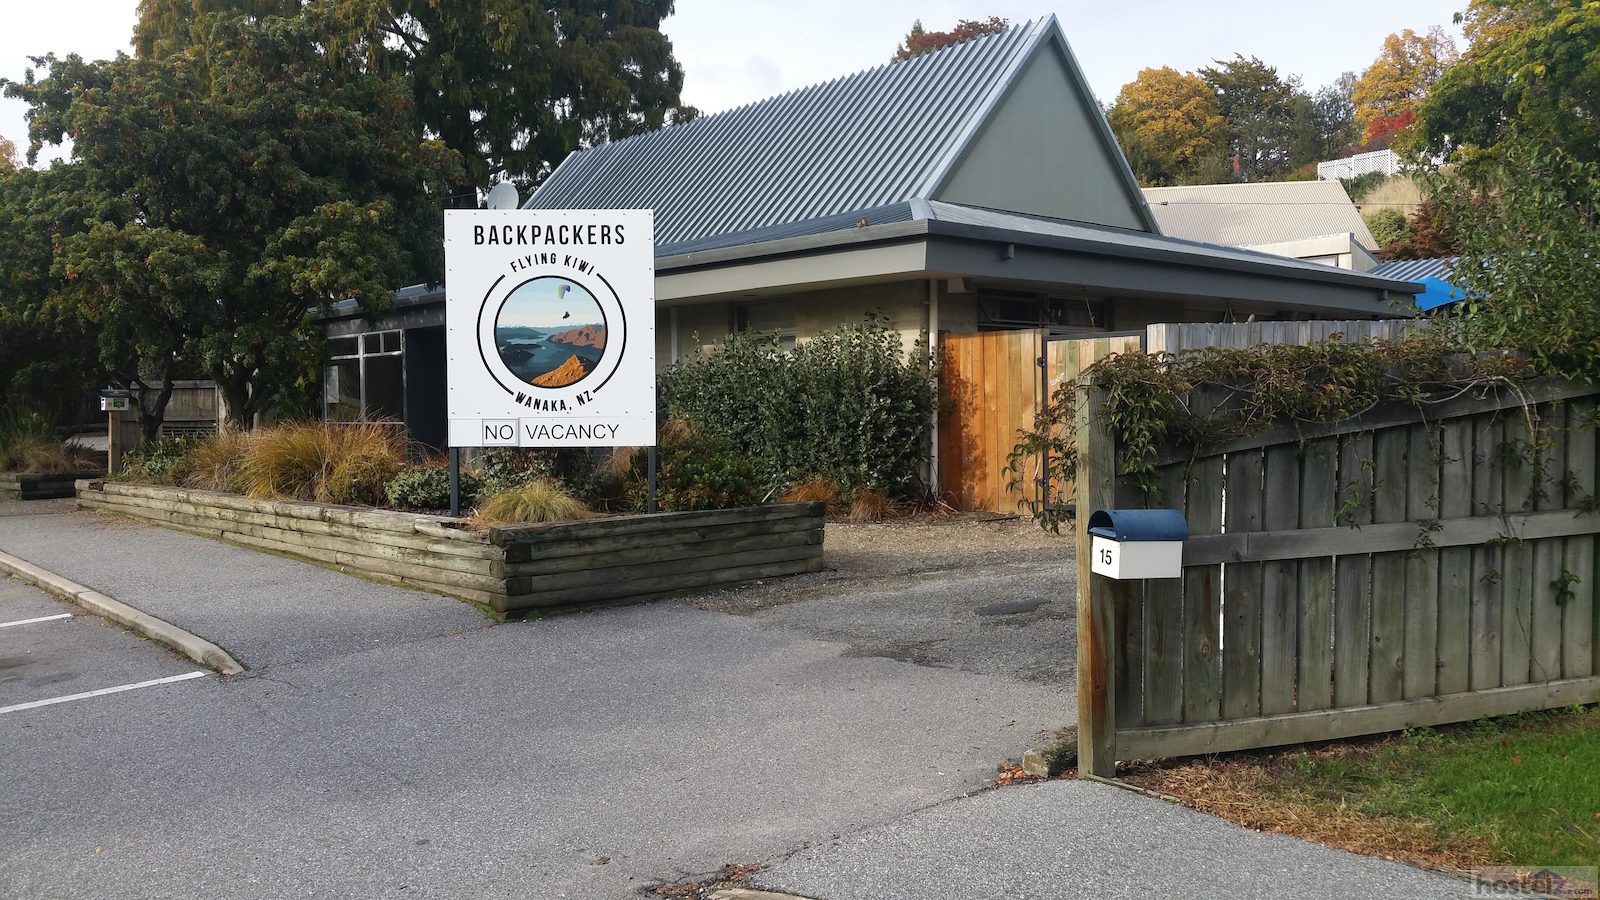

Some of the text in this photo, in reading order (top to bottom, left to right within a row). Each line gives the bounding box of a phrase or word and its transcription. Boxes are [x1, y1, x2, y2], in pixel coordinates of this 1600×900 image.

[474, 224, 625, 245] BACKPACKERS
[509, 252, 595, 276] FLYING KIWI
[514, 390, 593, 412] WANAKA, NZ
[484, 424, 620, 440] NO VACANCY
[1099, 548, 1112, 565] 15
